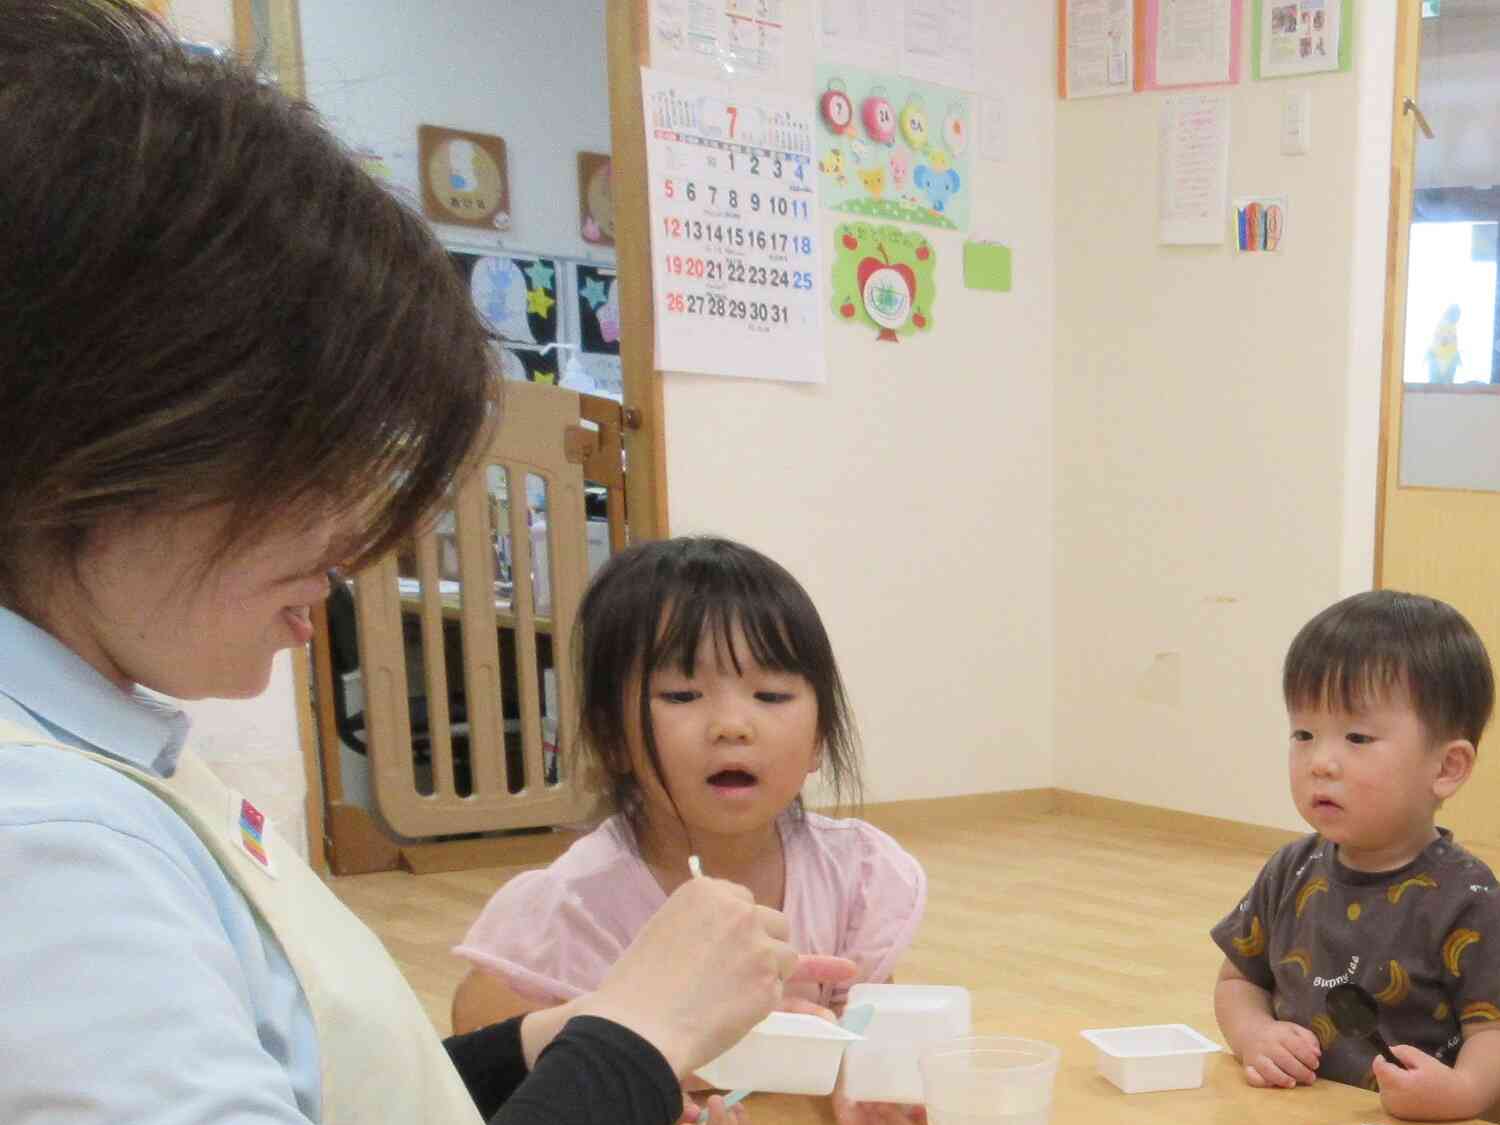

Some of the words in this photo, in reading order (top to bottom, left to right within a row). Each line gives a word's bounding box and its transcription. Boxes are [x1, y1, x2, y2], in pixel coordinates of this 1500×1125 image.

[726, 106, 737, 139] 7
[727, 153, 735, 171] 1
[750, 155, 760, 175] 2
[773, 159, 783, 178] 3
[794, 163, 804, 181] 4
[664, 179, 673, 198] 5
[686, 183, 696, 201] 6
[708, 186, 717, 204] 7
[729, 190, 738, 209] 8
[750, 193, 760, 212] 9
[770, 196, 788, 216] 10
[792, 199, 808, 218] 11
[664, 218, 681, 237] 12
[685, 221, 703, 240] 13
[706, 224, 722, 243] 14
[727, 227, 744, 246] 15
[748, 230, 767, 249] 16
[771, 234, 788, 252] 17
[793, 237, 811, 255] 18
[665, 256, 682, 275] 19
[685, 257, 704, 278] 20
[706, 260, 722, 280] 21
[728, 263, 745, 282] 22
[749, 266, 767, 285] 23
[770, 269, 789, 288] 24
[793, 272, 813, 290] 25
[666, 293, 684, 312] 26
[687, 295, 705, 314] 27
[708, 297, 726, 317] 28
[729, 300, 747, 319] 29
[750, 303, 768, 322] 30
[771, 305, 789, 324] 31
